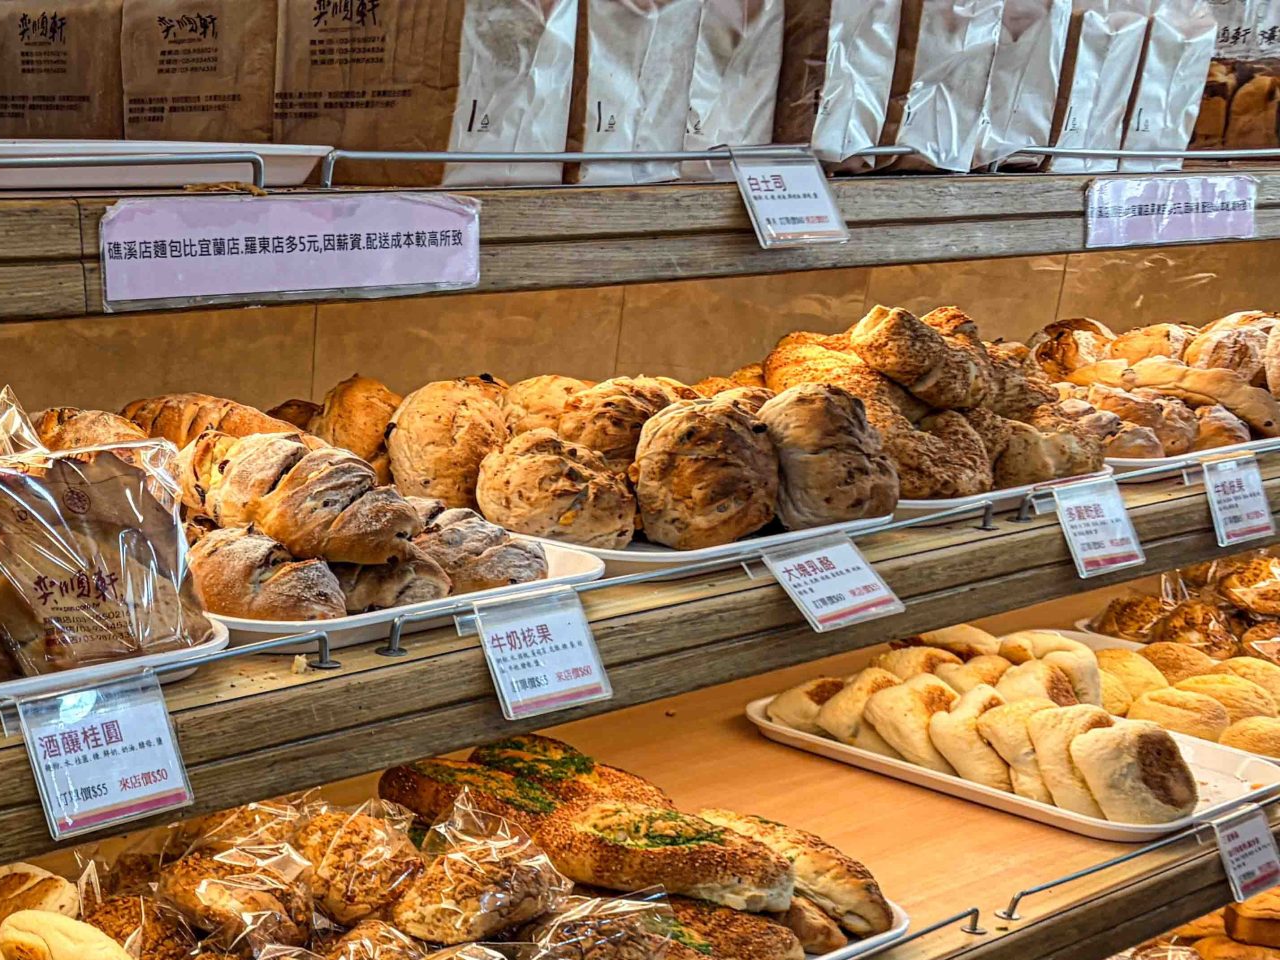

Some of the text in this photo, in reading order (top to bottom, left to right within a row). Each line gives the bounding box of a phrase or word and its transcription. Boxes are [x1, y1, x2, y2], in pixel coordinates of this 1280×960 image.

[747, 174, 787, 192] 白土司
[490, 624, 553, 653] 牛奶核果
[38, 720, 123, 760] 酒釀桂圓
